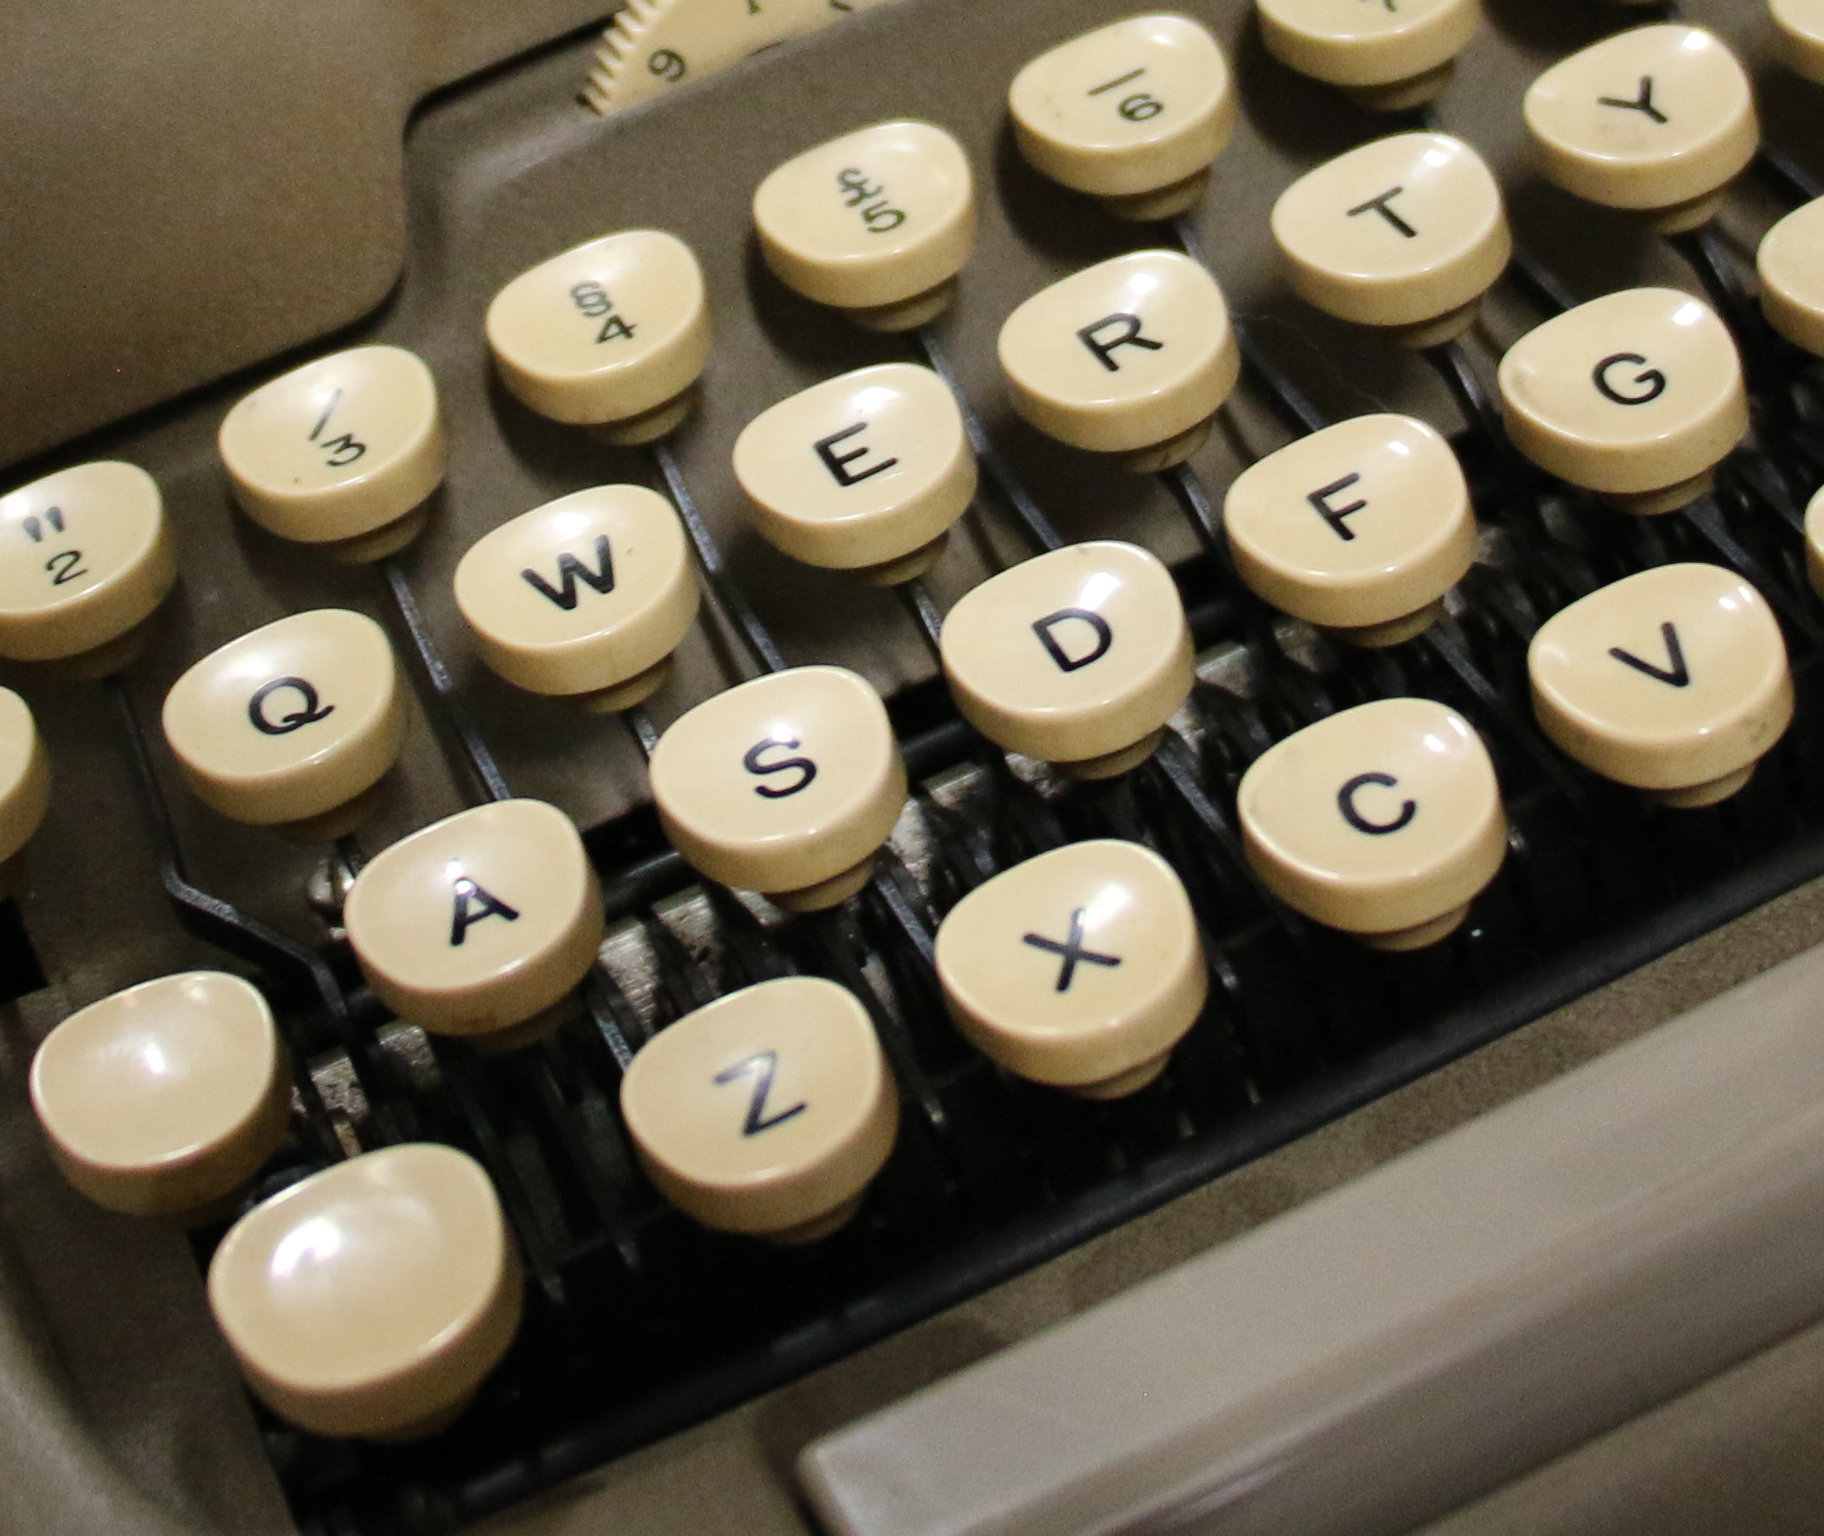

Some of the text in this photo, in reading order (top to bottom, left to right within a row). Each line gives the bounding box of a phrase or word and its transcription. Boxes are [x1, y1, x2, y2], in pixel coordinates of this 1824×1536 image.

[648, 48, 687, 83] 9
[1118, 93, 1165, 122] 6
[1599, 76, 1669, 124] Y
[836, 167, 885, 209] £
[861, 200, 907, 233] 5
[1347, 187, 1418, 239] T
[569, 279, 613, 318] §
[594, 313, 639, 345] 4
[1076, 310, 1164, 373] R
[1592, 352, 1667, 406] G
[322, 433, 367, 468] 3
[813, 420, 898, 488] E
[1307, 471, 1368, 542] F
[45, 549, 88, 586] 2
[520, 533, 616, 612] W
[1032, 607, 1114, 673] D
[1609, 622, 1691, 689] V
[248, 678, 336, 736] Q
[741, 736, 818, 800] S
[1336, 772, 1417, 837] C
[448, 875, 520, 948] A
[1021, 906, 1123, 994] X
[712, 1047, 809, 1139] Z
